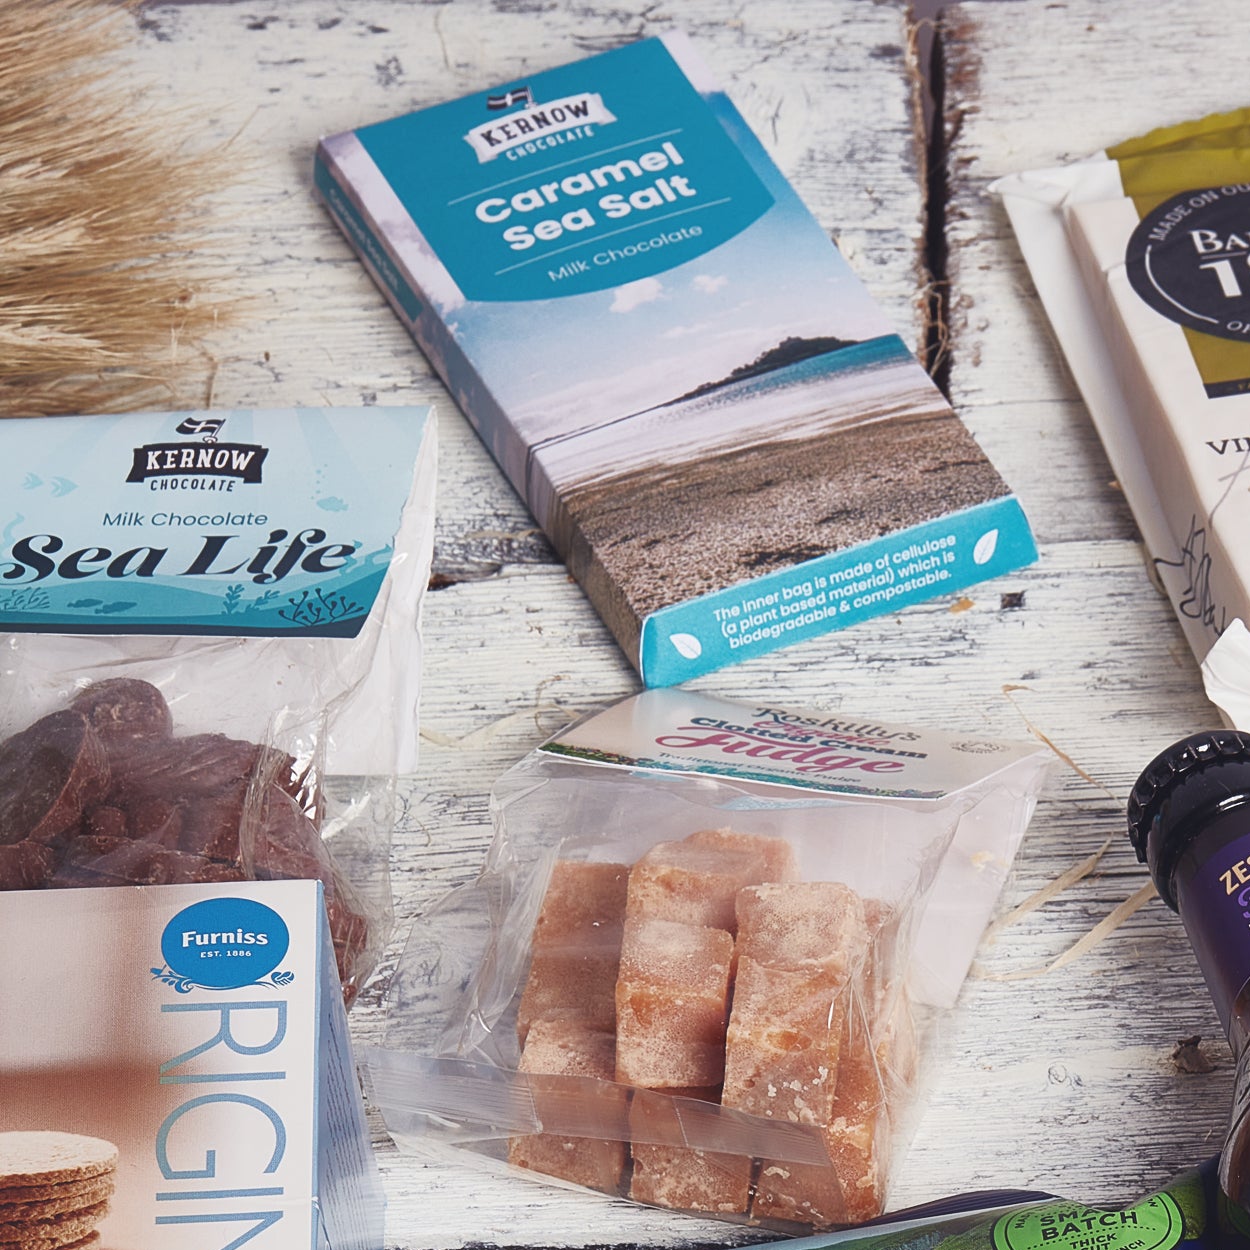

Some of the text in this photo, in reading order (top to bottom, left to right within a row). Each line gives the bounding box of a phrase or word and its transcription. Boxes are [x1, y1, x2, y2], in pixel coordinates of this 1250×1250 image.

[481, 100, 589, 147] KERNOW
[506, 125, 595, 161] CHOCOLATE
[475, 142, 684, 223] Caramel
[503, 175, 696, 250] Sea Salt
[1149, 204, 1192, 241] MADE
[1191, 190, 1218, 208] ON
[548, 225, 702, 282] Milk Chocolate
[146, 449, 255, 471] KERNOW
[150, 478, 236, 492] CHOCOLATE
[103, 512, 268, 527] Milk Chocolate
[0, 528, 357, 585] Sea Life
[830, 535, 956, 585] made cellulose
[730, 569, 952, 649] biodegradable compostable.
[781, 568, 894, 616] based material)
[690, 717, 928, 759] Clotted Cream
[752, 707, 921, 741] Roskilly's
[656, 726, 904, 773] Fudge
[182, 928, 268, 947] Furniss
[1042, 1211, 1137, 1241] BATCH
[1070, 1233, 1117, 1249] THICK
